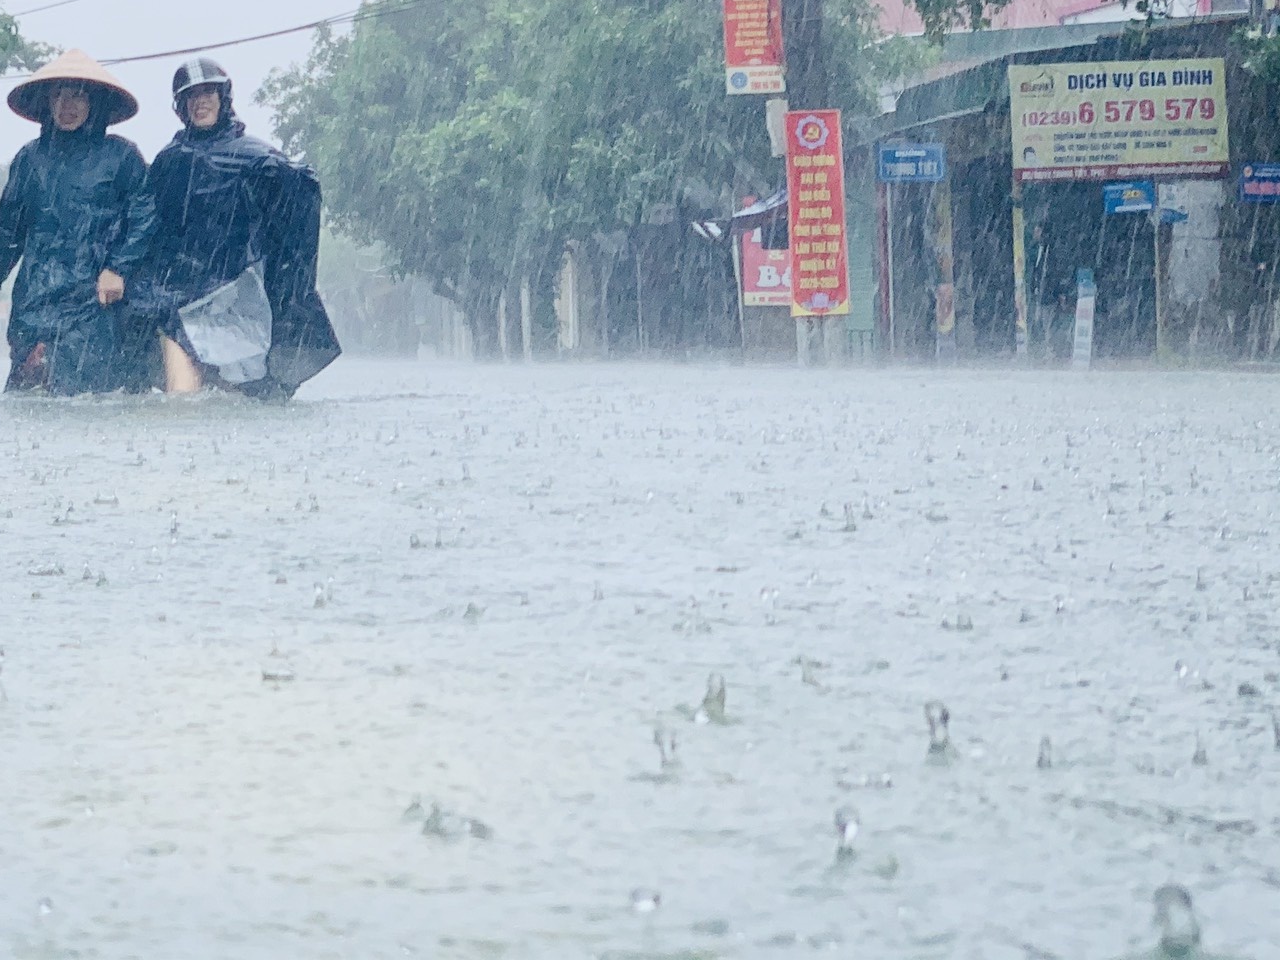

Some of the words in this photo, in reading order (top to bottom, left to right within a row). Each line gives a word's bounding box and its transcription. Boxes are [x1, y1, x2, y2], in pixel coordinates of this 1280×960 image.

[1067, 73, 1107, 93] DỊCH
[1112, 72, 1134, 92] VỤ
[1139, 71, 1167, 87] GIA
[1172, 67, 1213, 86] ĐÌNH
[1104, 99, 1155, 123] 579
[1164, 97, 1215, 121] 579
